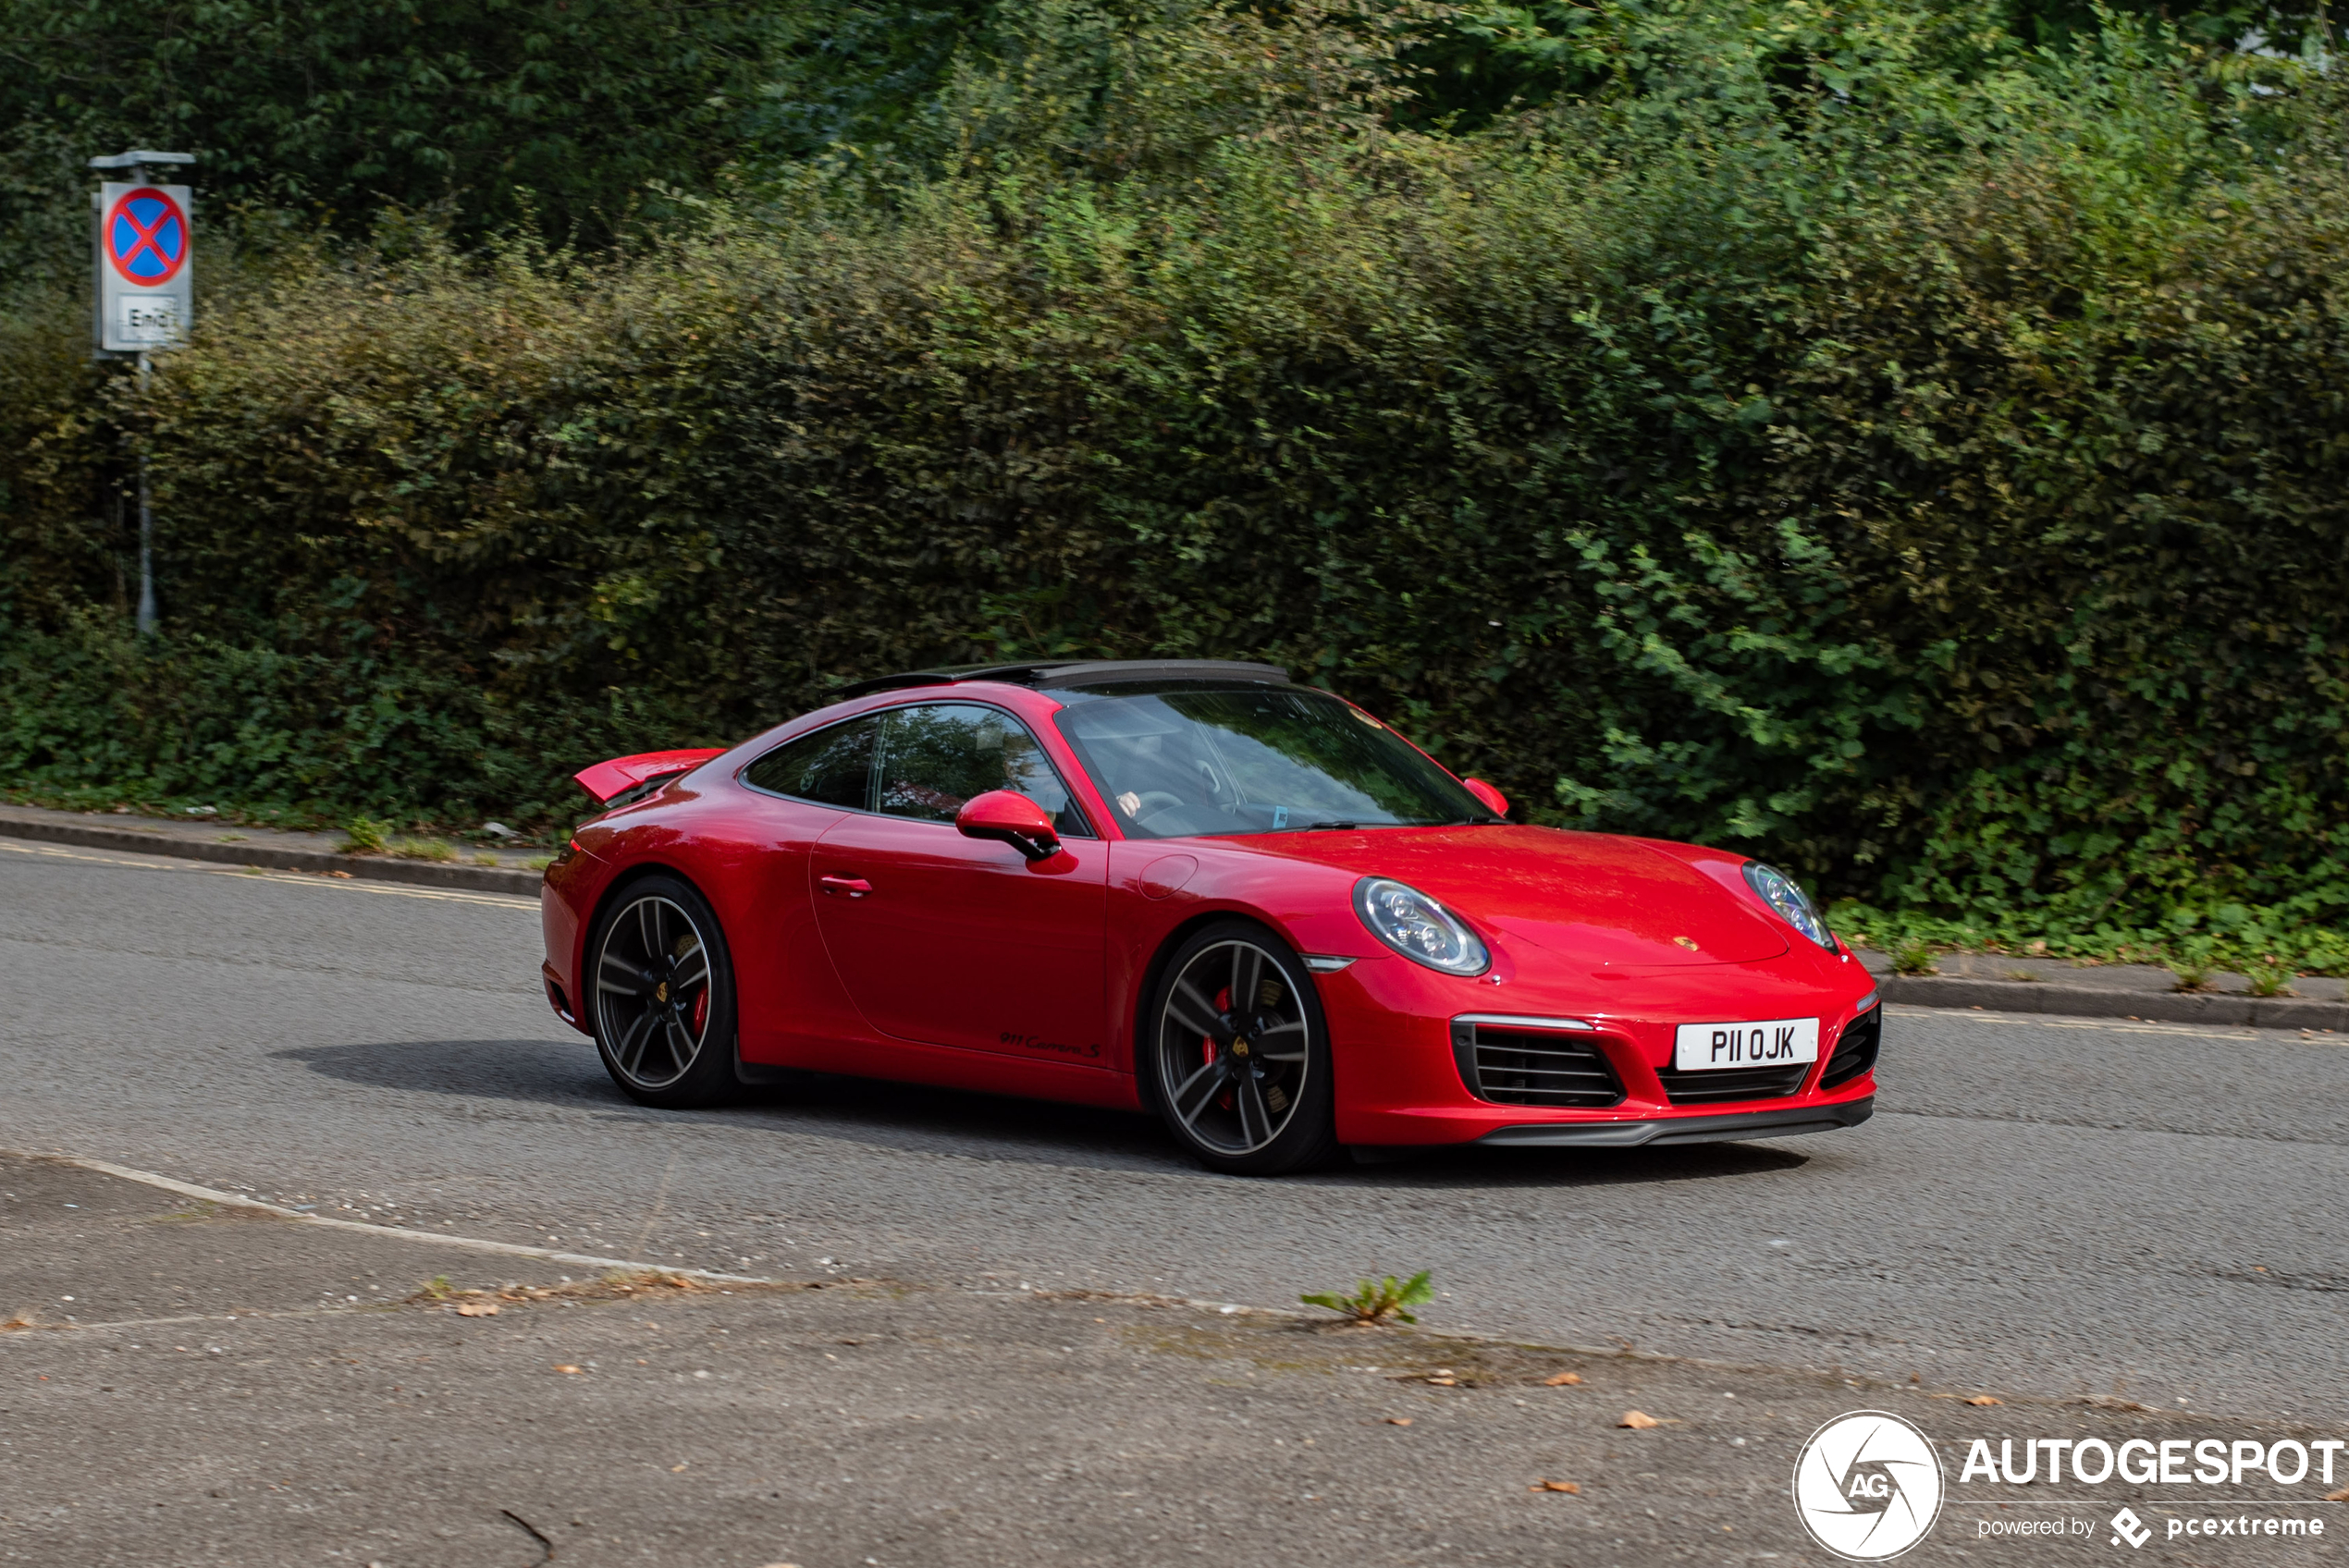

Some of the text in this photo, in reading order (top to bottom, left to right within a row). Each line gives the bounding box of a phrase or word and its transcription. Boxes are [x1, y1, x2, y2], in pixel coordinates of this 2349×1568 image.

[1000, 1032, 1101, 1058] 911 Carrera S
[1750, 1026, 1795, 1060] OJK
